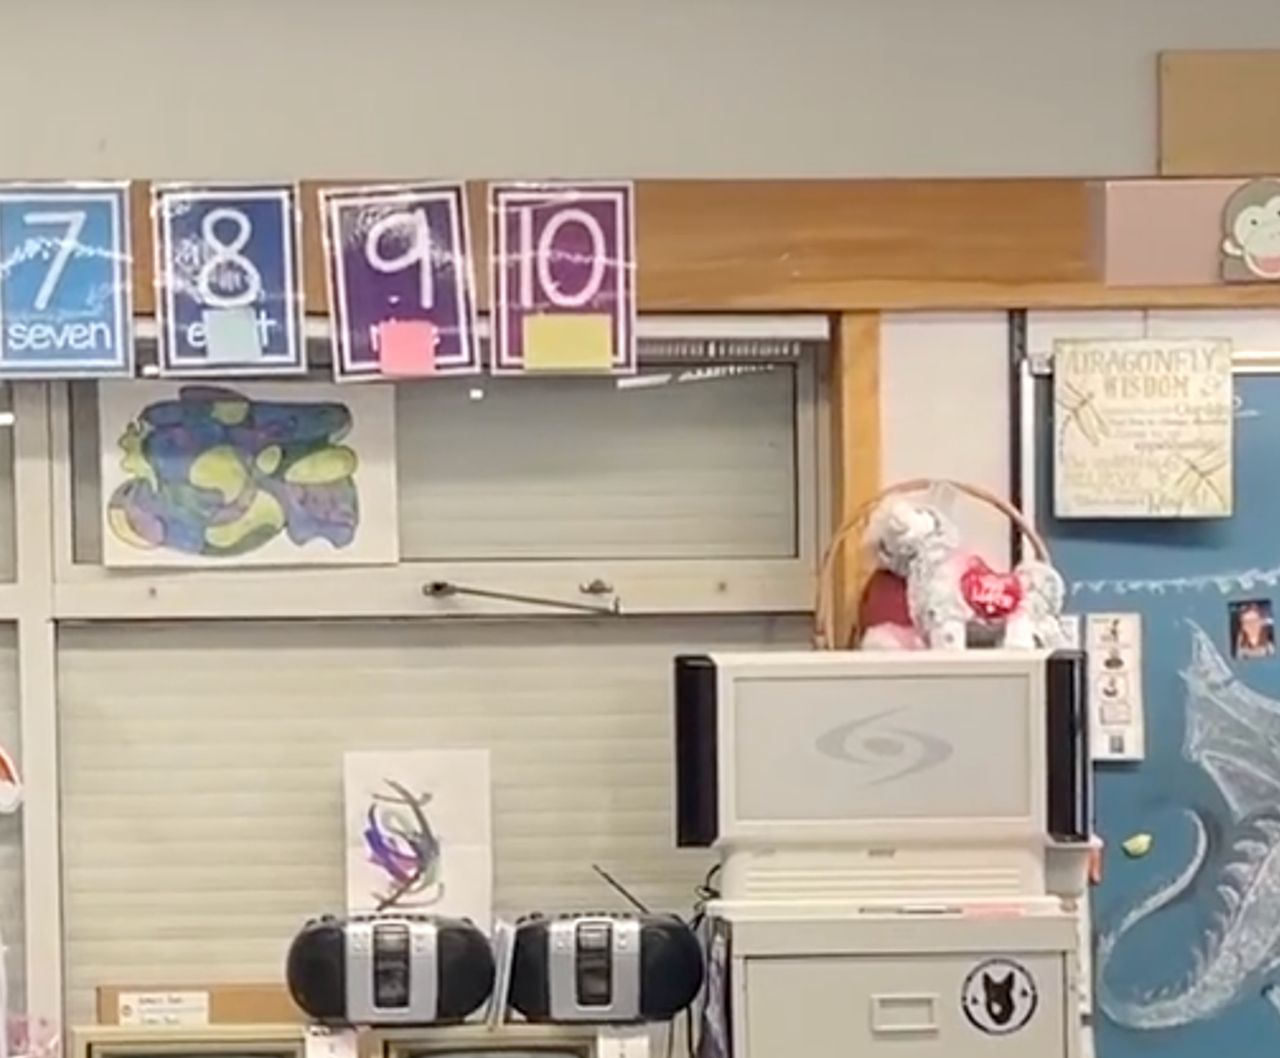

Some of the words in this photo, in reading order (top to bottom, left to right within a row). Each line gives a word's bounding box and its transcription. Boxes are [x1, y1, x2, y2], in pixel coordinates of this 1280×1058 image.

[23, 210, 88, 310] 7
[199, 207, 261, 308] 8
[365, 207, 433, 309] 9
[519, 207, 608, 307] 10
[7, 319, 114, 352] seven
